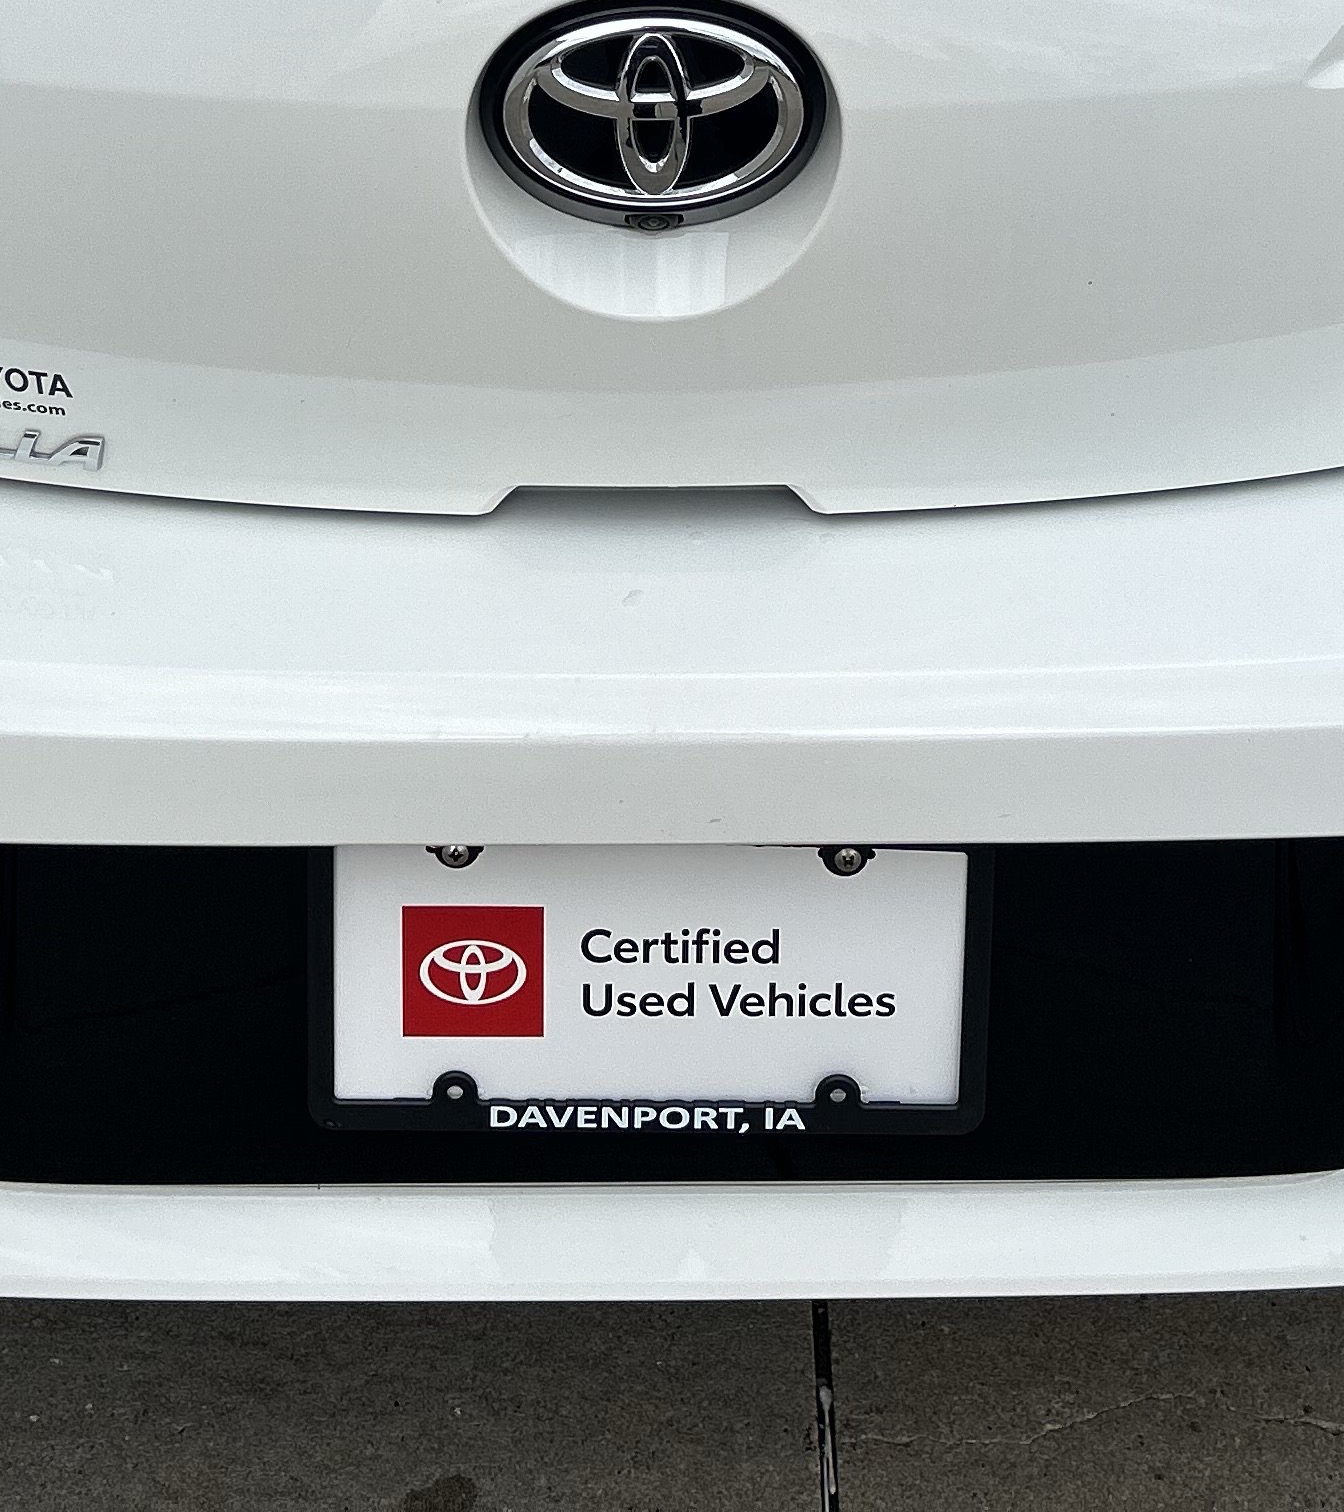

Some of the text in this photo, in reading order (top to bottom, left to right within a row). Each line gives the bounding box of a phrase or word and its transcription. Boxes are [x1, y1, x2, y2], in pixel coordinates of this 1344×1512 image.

[580, 928, 780, 965] Certified
[582, 982, 897, 1018] Used Vehicles
[489, 1105, 806, 1133] DAVENPORT, IA
